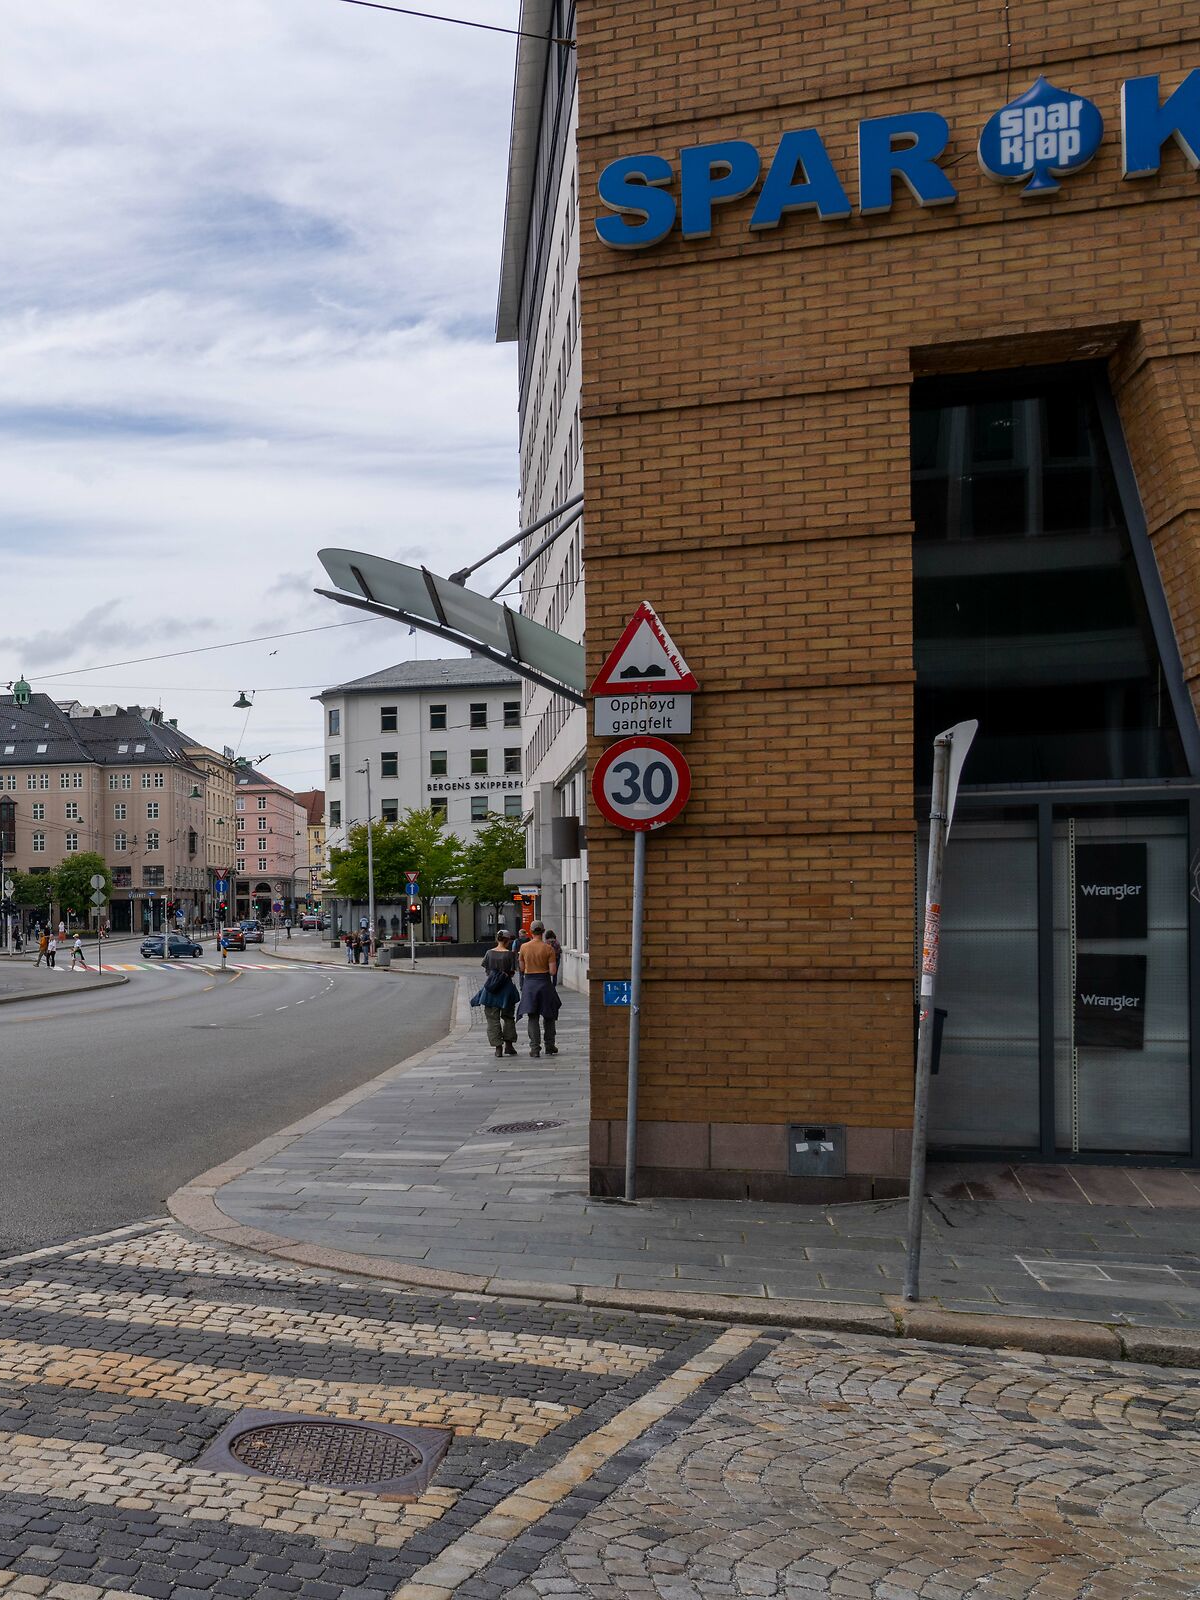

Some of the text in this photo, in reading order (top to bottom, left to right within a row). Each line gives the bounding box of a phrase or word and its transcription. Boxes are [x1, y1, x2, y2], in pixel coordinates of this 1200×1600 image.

[999, 99, 1083, 141] spar
[1000, 129, 1081, 170] kjøp
[595, 111, 958, 250] SPAR
[610, 698, 675, 713] Opphøyd
[612, 717, 673, 733] gangfelt
[427, 782, 471, 791] BERGENS
[611, 761, 673, 805] 30
[1081, 884, 1142, 901] Wrangler
[1081, 993, 1140, 1011] Wrangler
